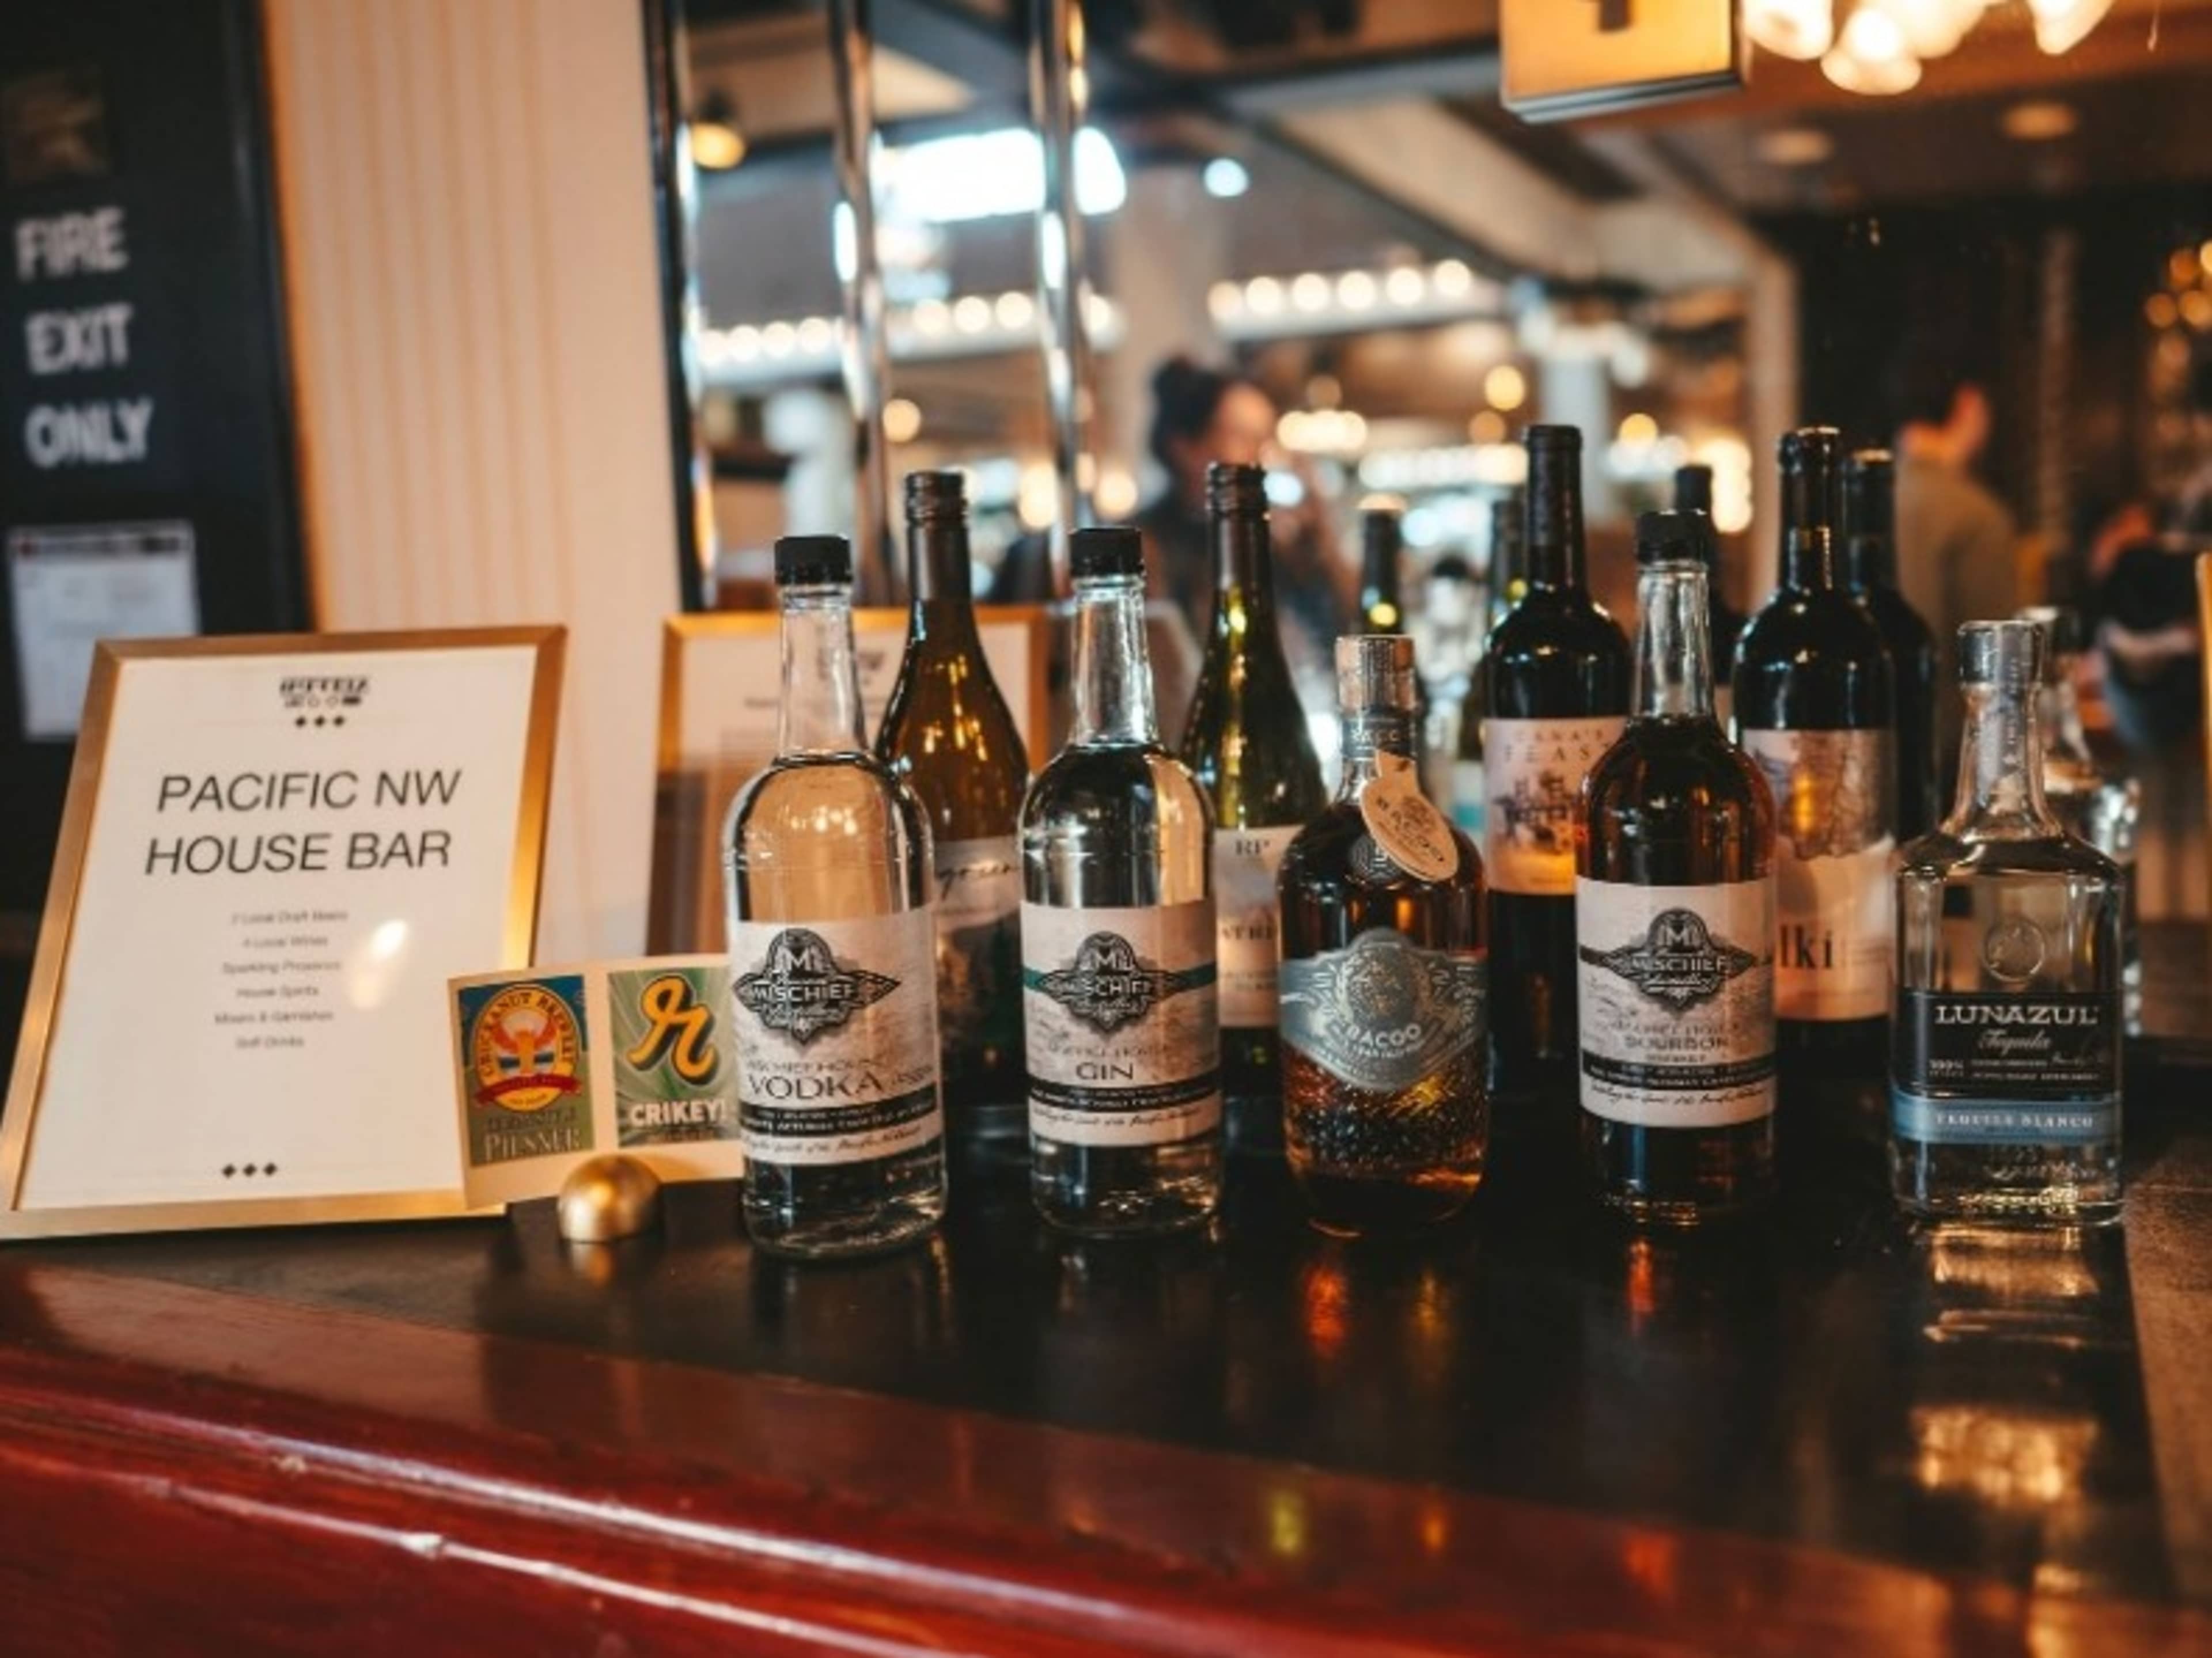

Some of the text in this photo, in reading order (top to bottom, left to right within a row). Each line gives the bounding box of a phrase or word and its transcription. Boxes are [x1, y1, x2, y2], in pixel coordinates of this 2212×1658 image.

[16, 207, 128, 280] FIRE
[26, 303, 132, 374] EXIT
[26, 395, 153, 468] ONLY
[157, 769, 462, 812] PACIFIC NW
[145, 830, 452, 875] HOUSE BAR
[751, 981, 858, 1002] MISCHIEF
[1934, 1005, 2099, 1026] LUNAZUL
[748, 1071, 884, 1101] VODKA
[1075, 1061, 1134, 1081] GIN
